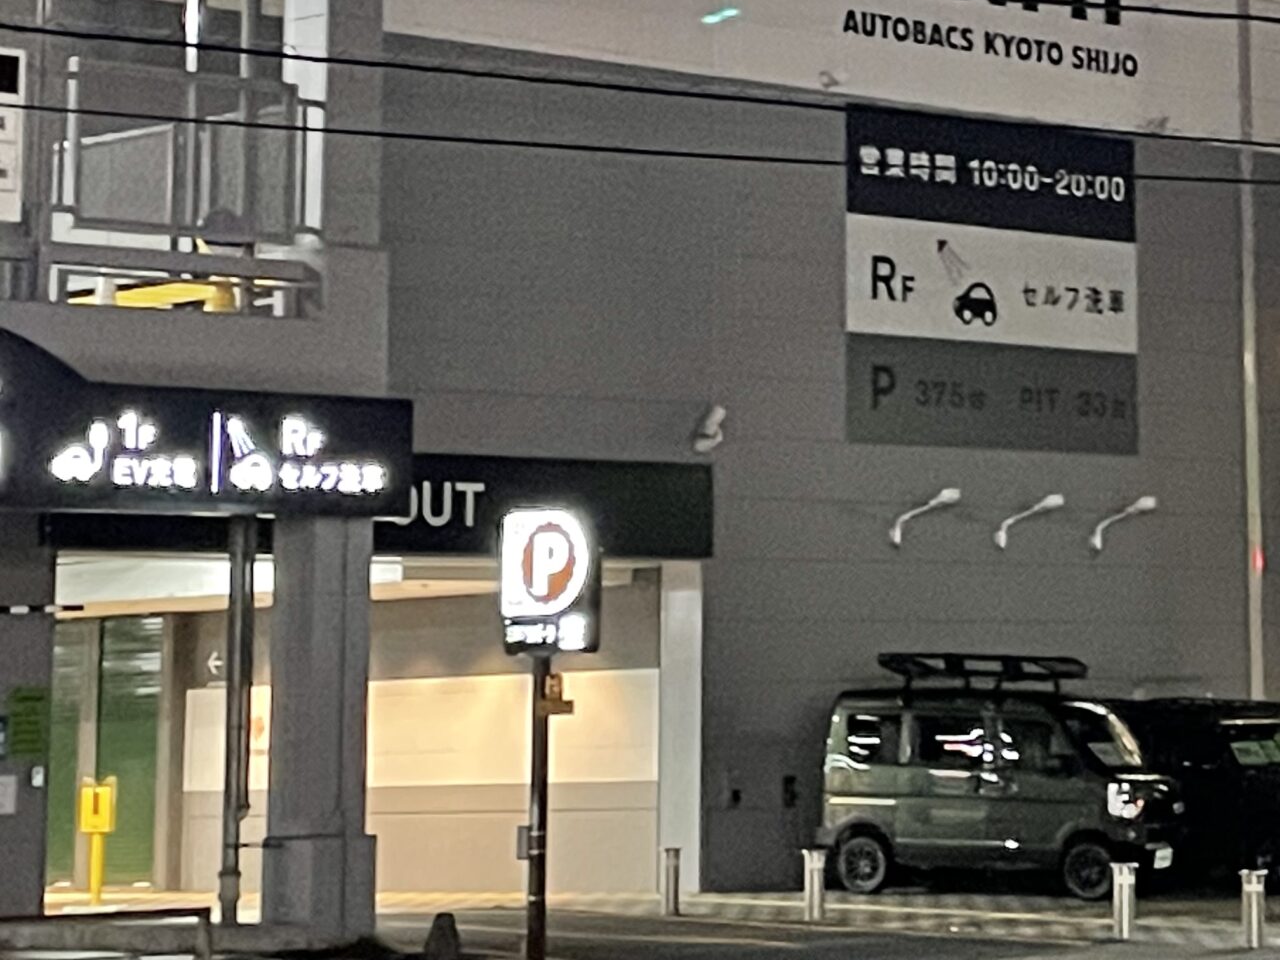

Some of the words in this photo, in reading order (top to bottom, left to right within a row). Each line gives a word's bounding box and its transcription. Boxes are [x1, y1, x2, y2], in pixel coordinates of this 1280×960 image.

[843, 9, 974, 52] AUTOBACS
[984, 30, 1063, 66] KYOTO
[1071, 46, 1139, 78] SHIJO
[871, 365, 897, 411] P
[410, 481, 486, 528] UT
[531, 531, 570, 598] P
